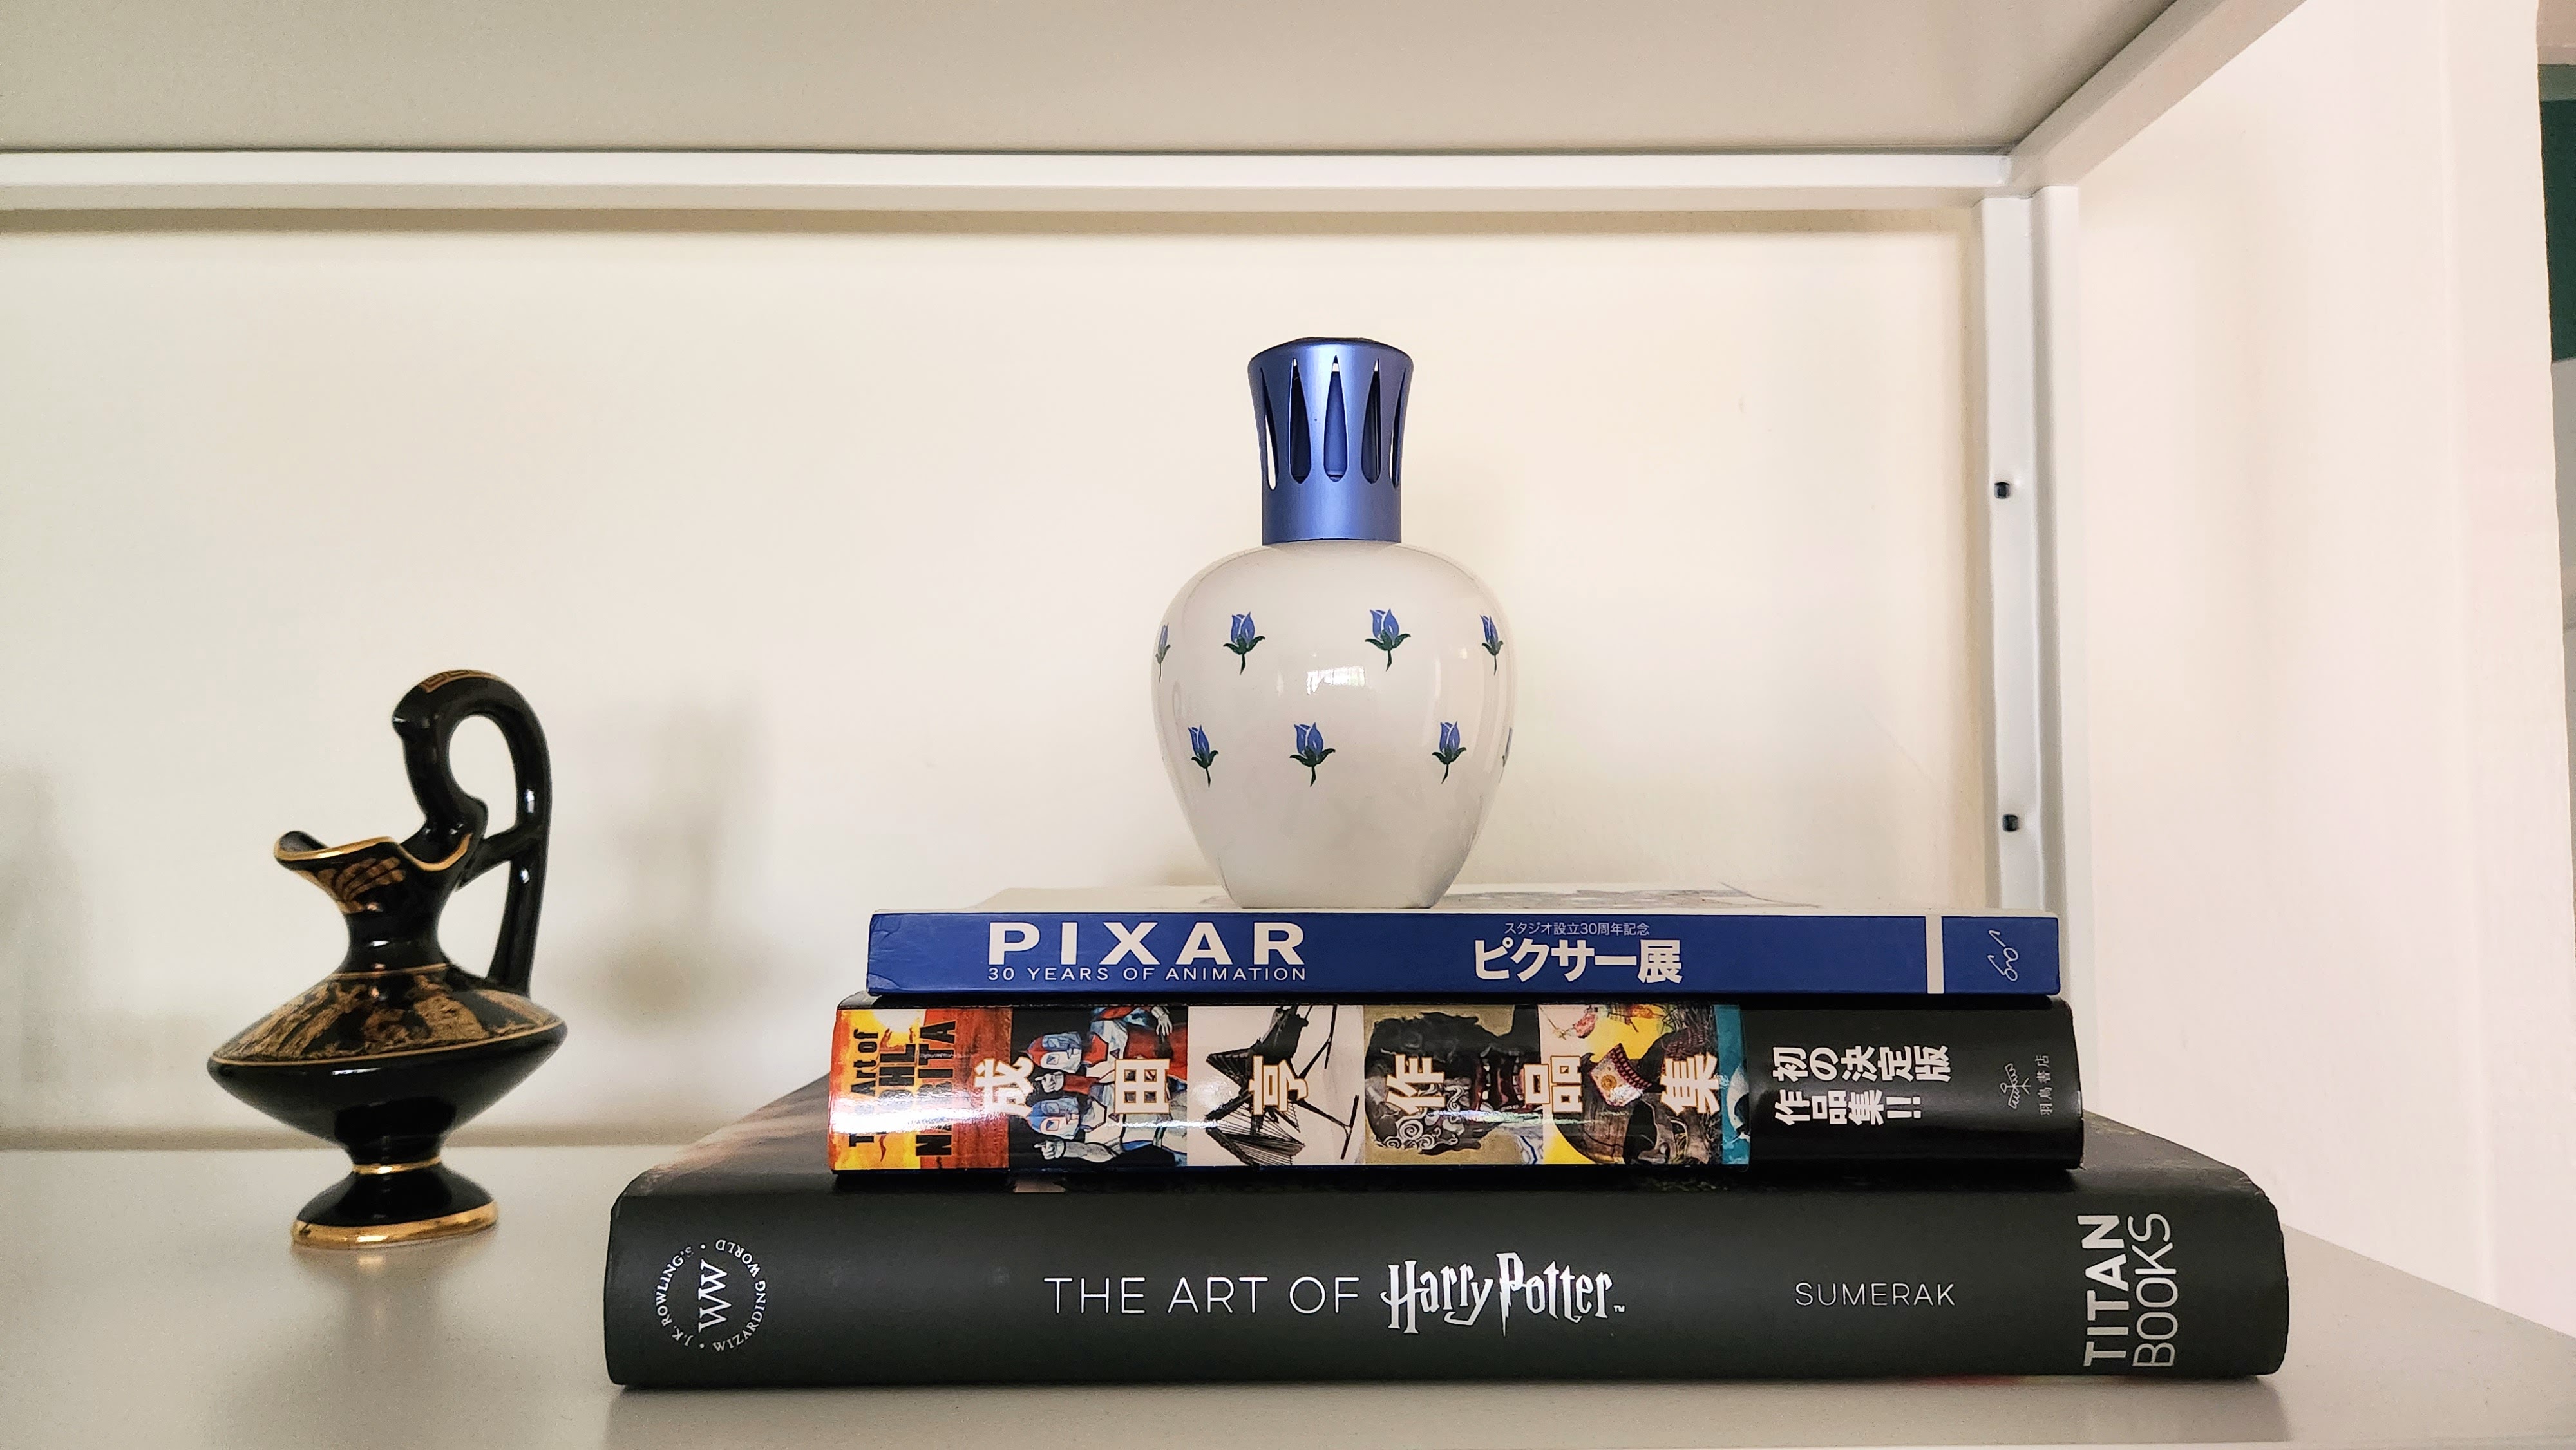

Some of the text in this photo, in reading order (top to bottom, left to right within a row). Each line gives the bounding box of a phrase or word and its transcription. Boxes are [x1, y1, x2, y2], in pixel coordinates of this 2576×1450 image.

[988, 921, 1305, 965] PIXAR
[1504, 922, 1650, 936] スタジオ設立30周年記念
[988, 967, 1305, 981] 30 YEARS OF ANIMATION
[1475, 937, 1683, 983] ピクサー展
[853, 1028, 878, 1053] of
[851, 1059, 876, 1097] Art
[1772, 1045, 1951, 1083] 初の決定版
[715, 1239, 761, 1278] WORLD
[1043, 1276, 1146, 1314] THE
[1167, 1276, 1269, 1314] ART
[1289, 1276, 1360, 1315] OF
[1379, 1260, 1494, 1334] Harry
[1795, 1282, 1955, 1306] SUMERAK
[2077, 1213, 2130, 1367] TITAN
[2127, 1212, 2179, 1368] BOOKS
[712, 1280, 766, 1351] WIZARDING
